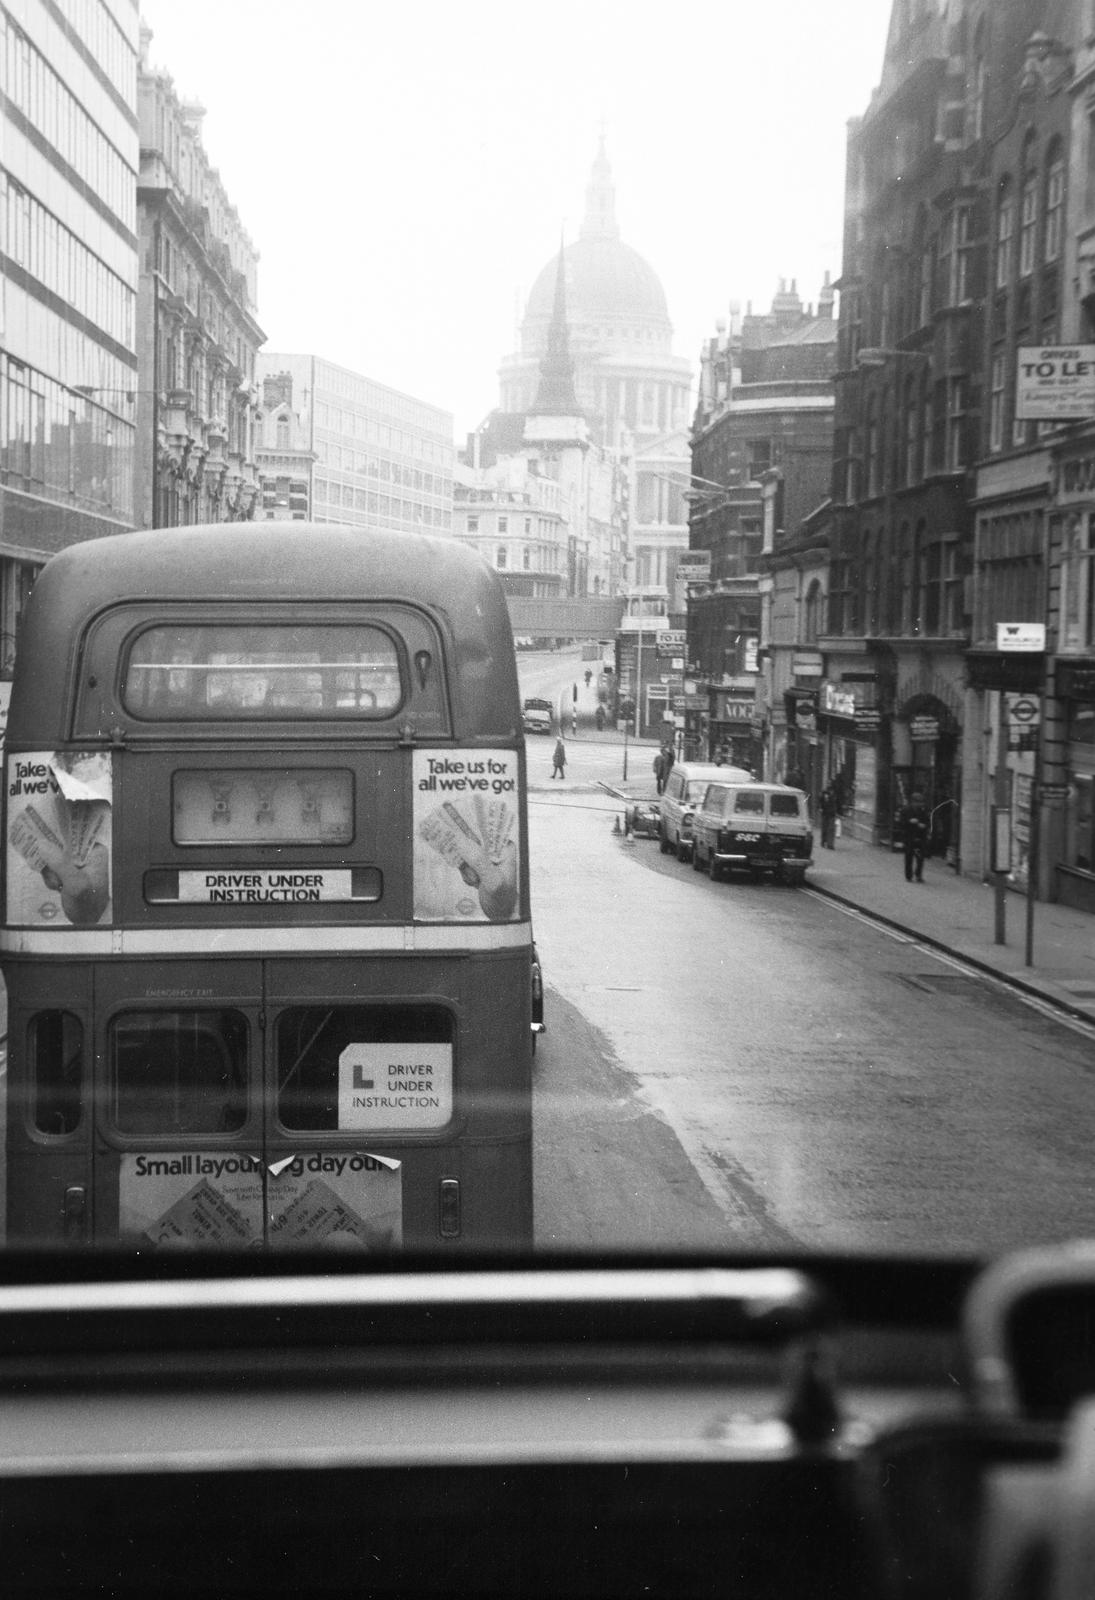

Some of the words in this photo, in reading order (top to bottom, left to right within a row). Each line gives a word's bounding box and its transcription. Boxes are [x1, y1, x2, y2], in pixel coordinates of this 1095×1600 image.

[1021, 362, 1055, 377] TO
[674, 634, 684, 642] LE
[15, 761, 47, 778] Take
[428, 758, 465, 774] Take
[467, 762, 485, 774] us
[487, 758, 507, 774] for
[9, 779, 22, 797] all
[23, 779, 61, 795] we'v
[418, 775, 437, 791] all
[439, 776, 489, 791] we've
[491, 778, 515, 795] got
[205, 874, 263, 888] DRIVER
[268, 874, 324, 888] UNDER
[209, 889, 320, 902] INSTRUCTION
[353, 1065, 374, 1089] L
[388, 1064, 434, 1076] DRIVER
[387, 1080, 434, 1092] UNDER
[352, 1096, 440, 1108] INSTRUCTION
[136, 1155, 192, 1177] Small
[307, 1153, 347, 1177] day
